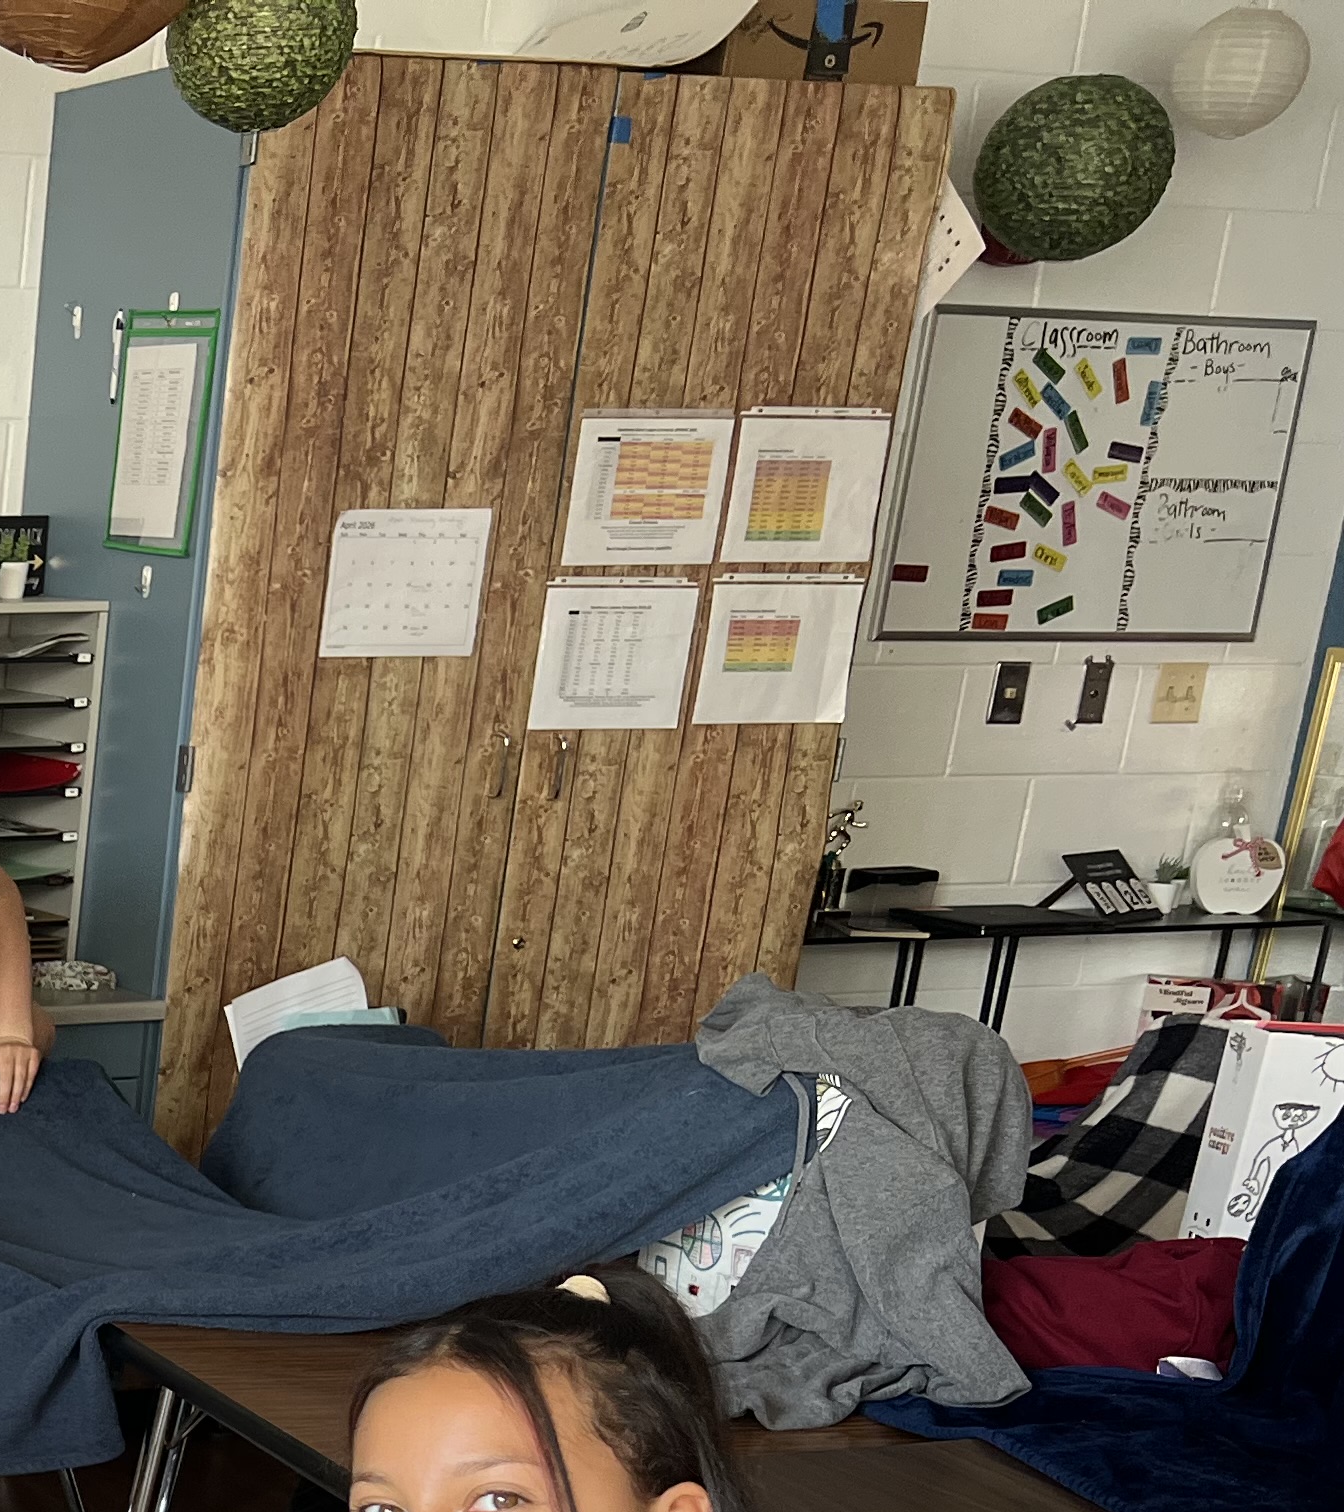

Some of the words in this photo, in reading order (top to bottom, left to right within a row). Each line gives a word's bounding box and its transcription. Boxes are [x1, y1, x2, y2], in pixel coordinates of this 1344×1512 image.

[1021, 321, 1118, 358] Classroom
[1182, 329, 1270, 358] Bathroom
[1204, 358, 1236, 383] Boys
